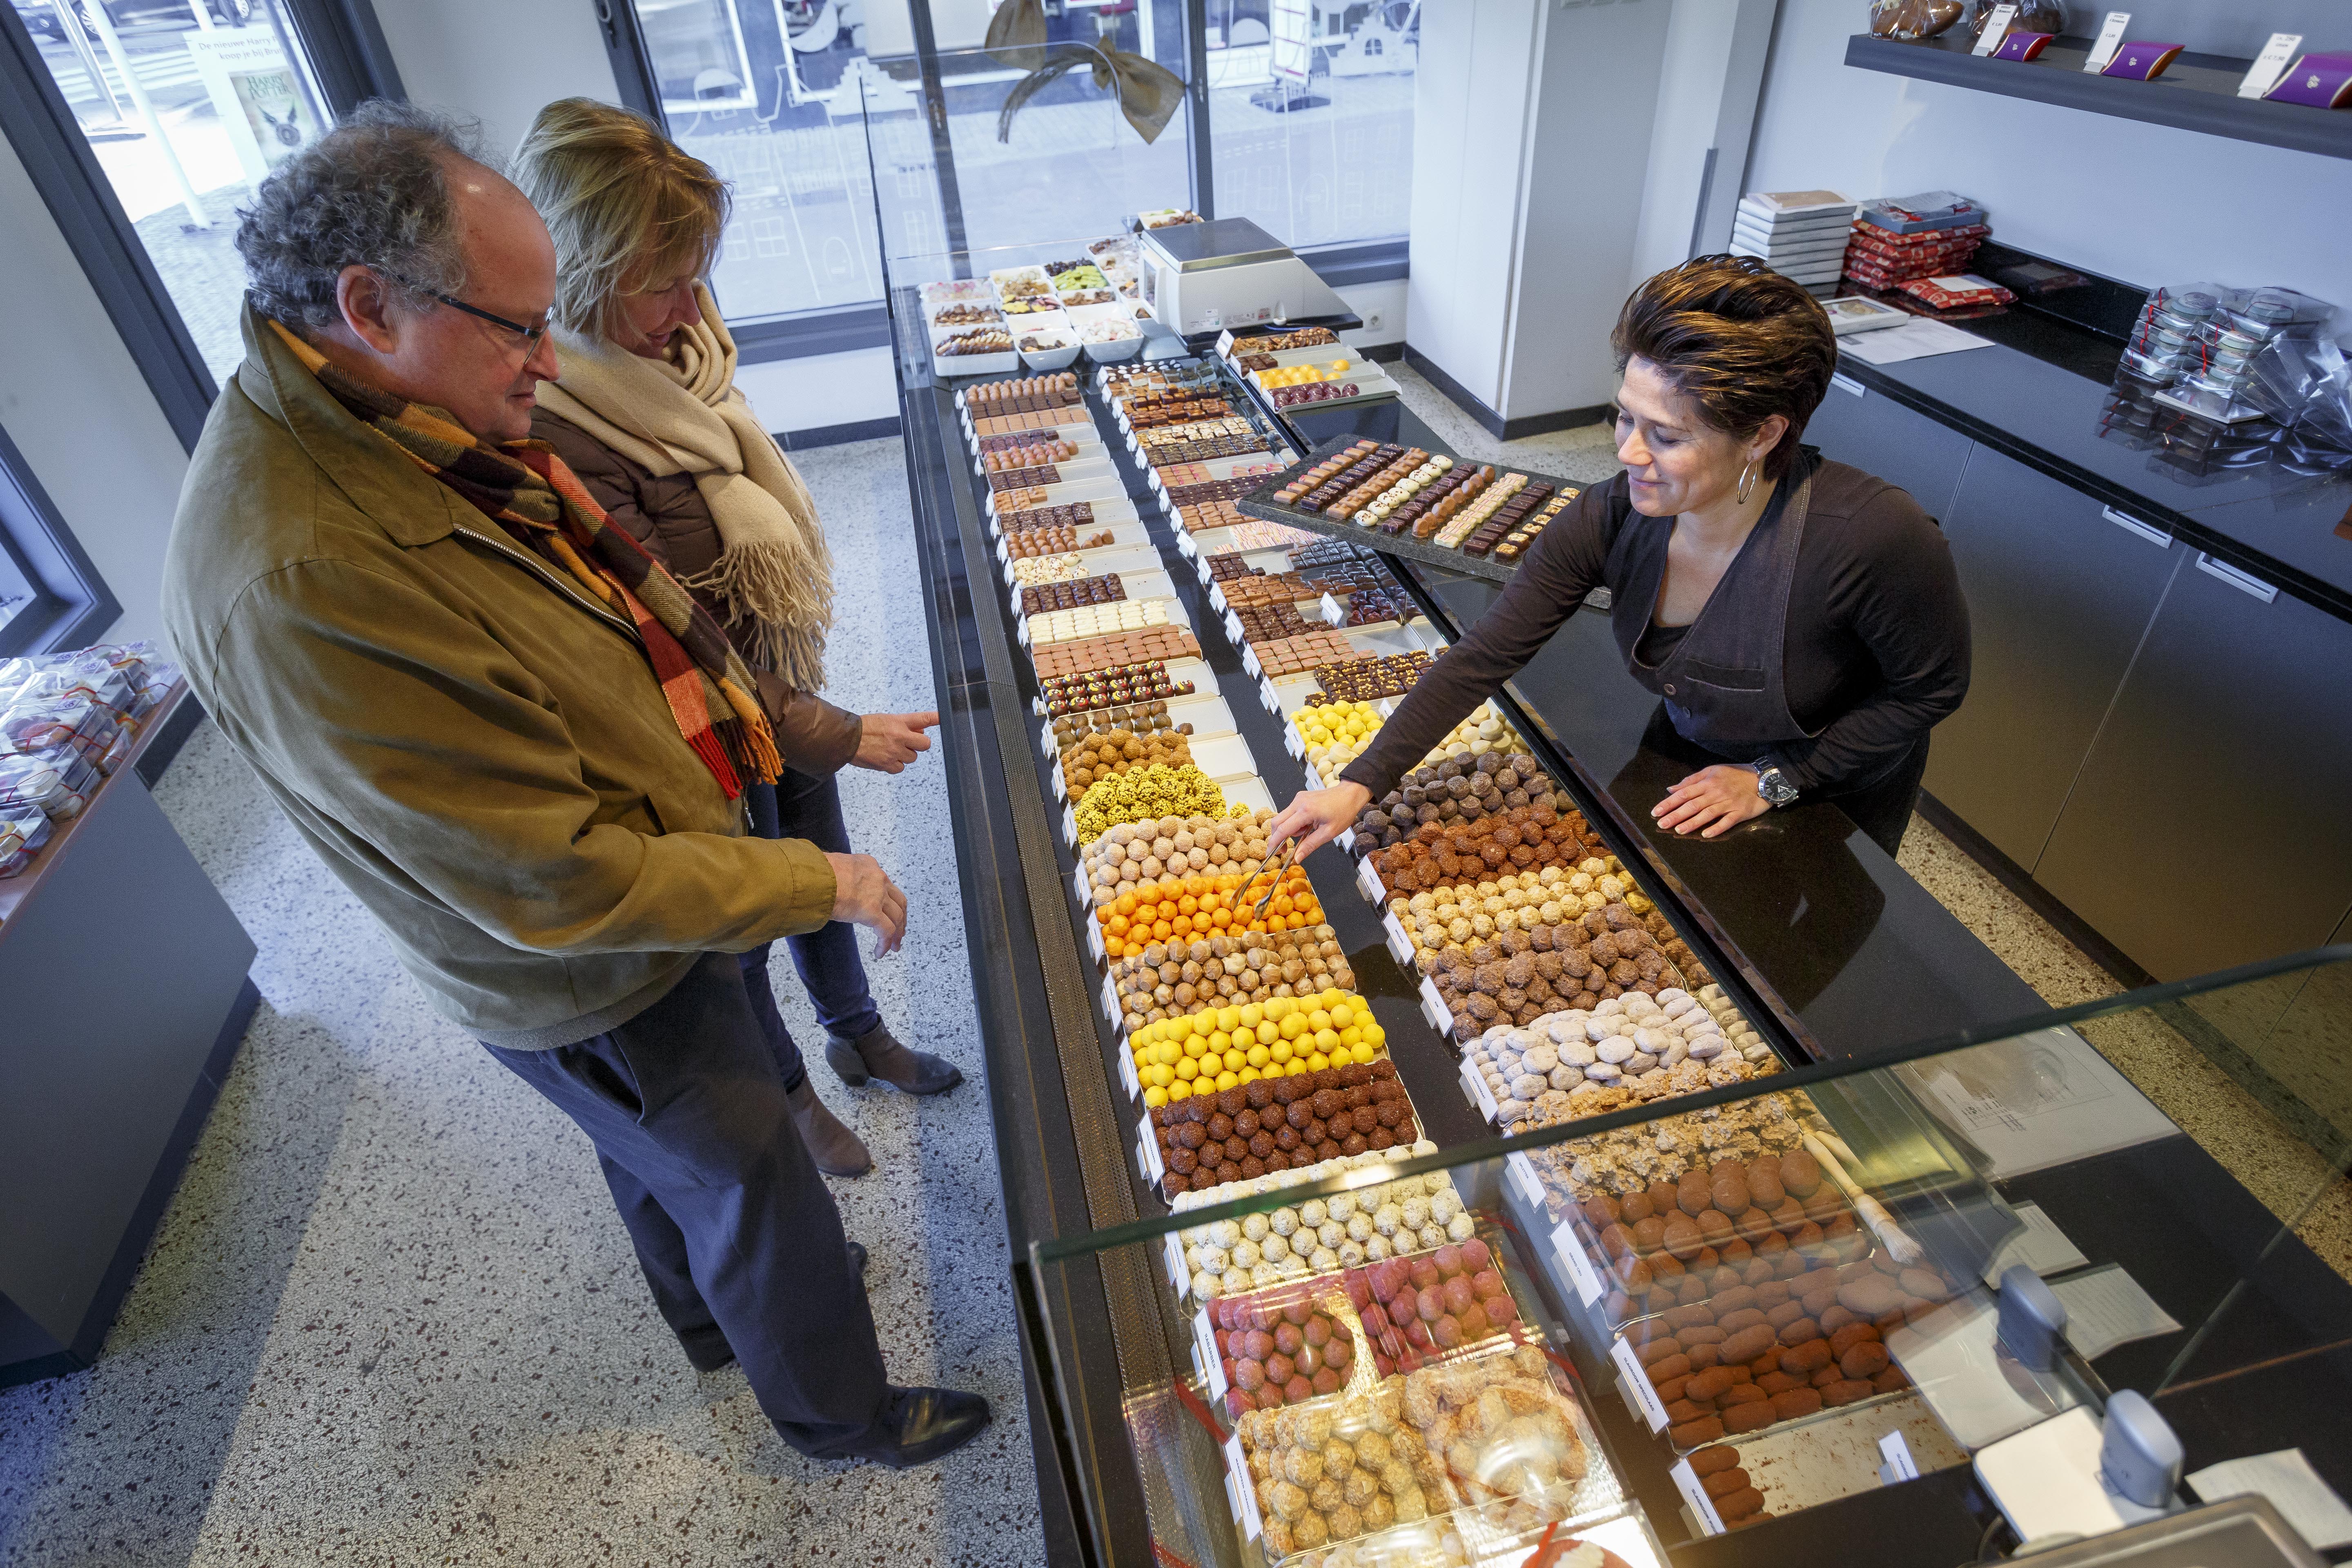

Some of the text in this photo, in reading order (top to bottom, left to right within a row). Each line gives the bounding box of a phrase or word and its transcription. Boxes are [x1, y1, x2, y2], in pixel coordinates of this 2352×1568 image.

[214, 41, 245, 49] nieuwe
[246, 38, 270, 46] Harry
[251, 48, 264, 58] bij
[246, 76, 285, 91] HARRY
[1518, 1162, 1529, 1179] SPLITTER
[1568, 1252, 1578, 1267] GRAND
[1204, 1332, 1216, 1370] RABARBER
[1623, 1356, 1655, 1412] SLAGROOM SPECULAAS
[1235, 1457, 1251, 1517] MARSEPEIN AMANDEL
